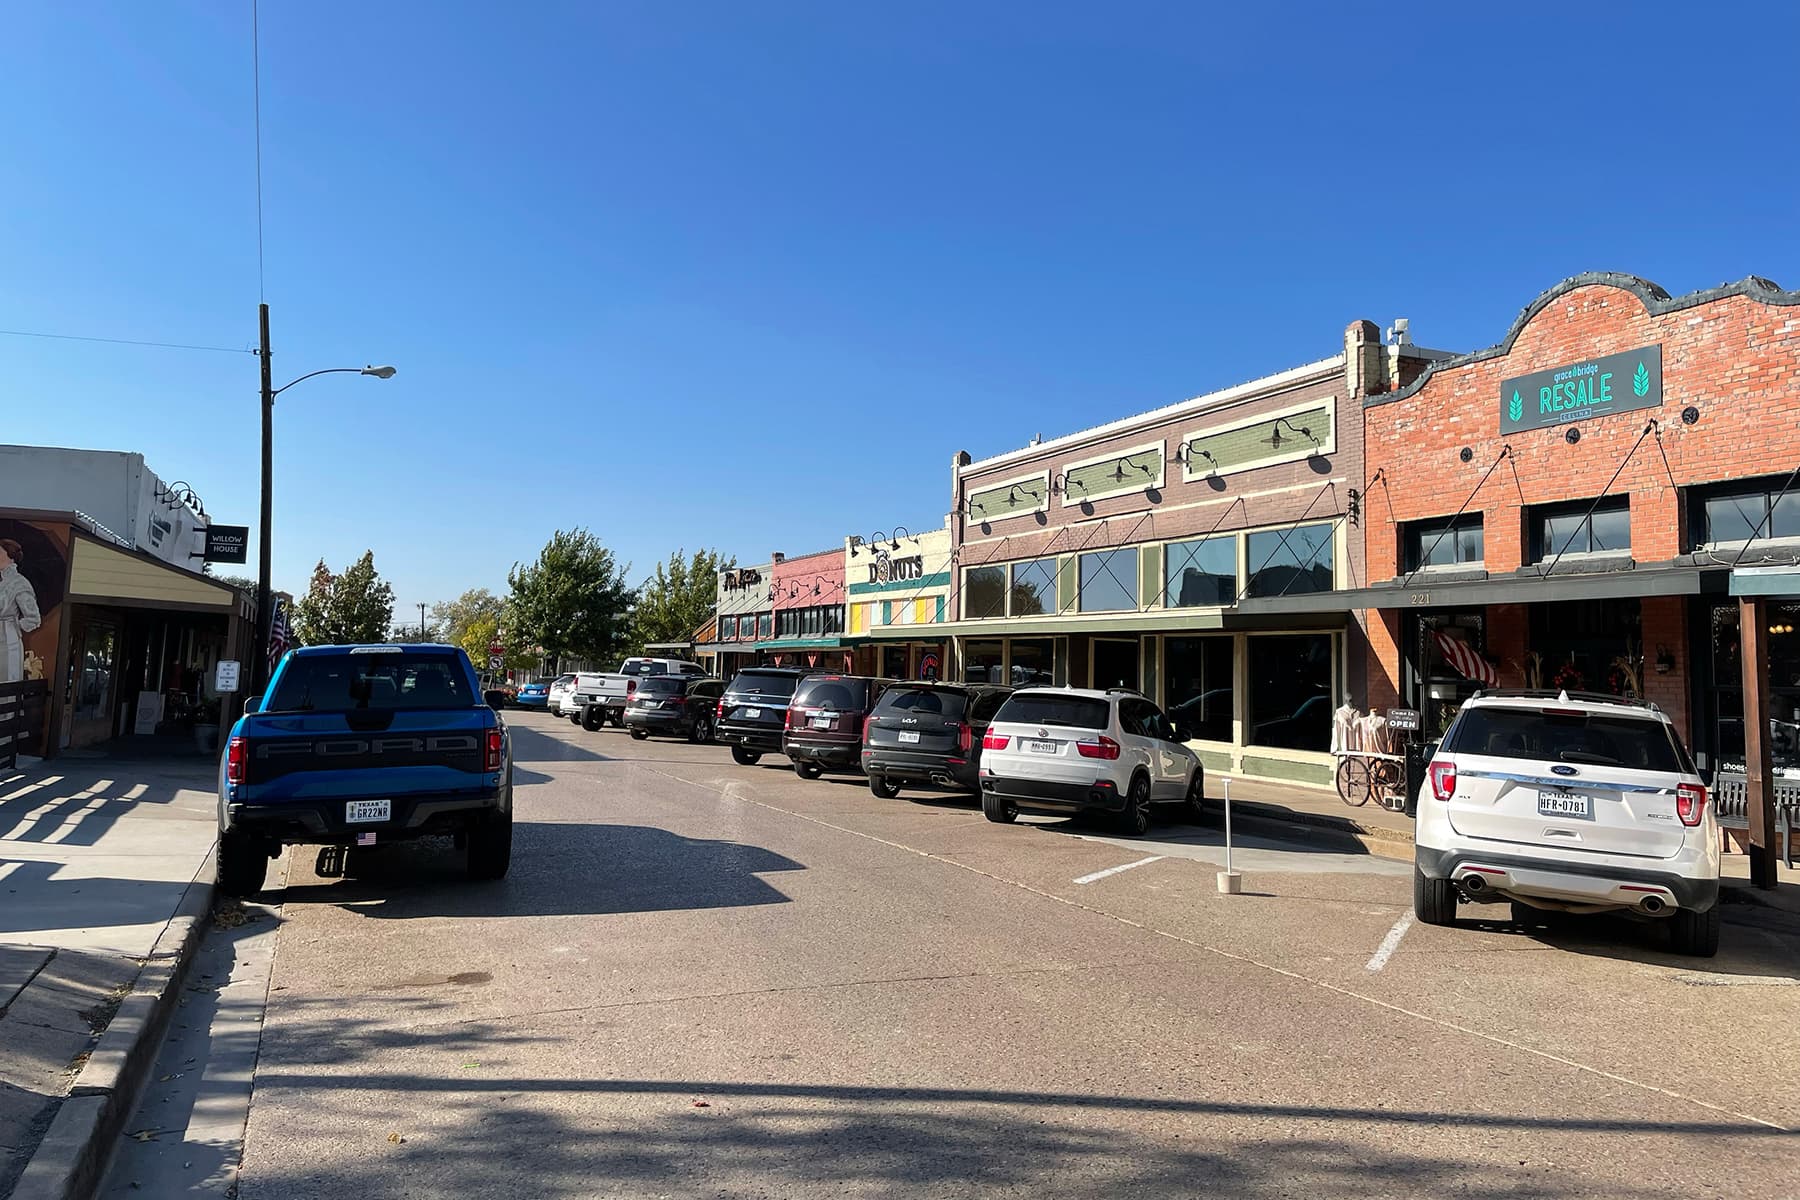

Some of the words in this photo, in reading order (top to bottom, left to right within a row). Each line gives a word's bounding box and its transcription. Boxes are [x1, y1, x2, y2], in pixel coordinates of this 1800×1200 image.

[1539, 372, 1613, 414] RESALE
[212, 535, 242, 543] WILLOW
[213, 545, 239, 553] HOUSE
[868, 553, 923, 585] DONUTS
[1411, 593, 1431, 605] 221
[1389, 719, 1416, 728] OPEN
[256, 736, 478, 758] FORD
